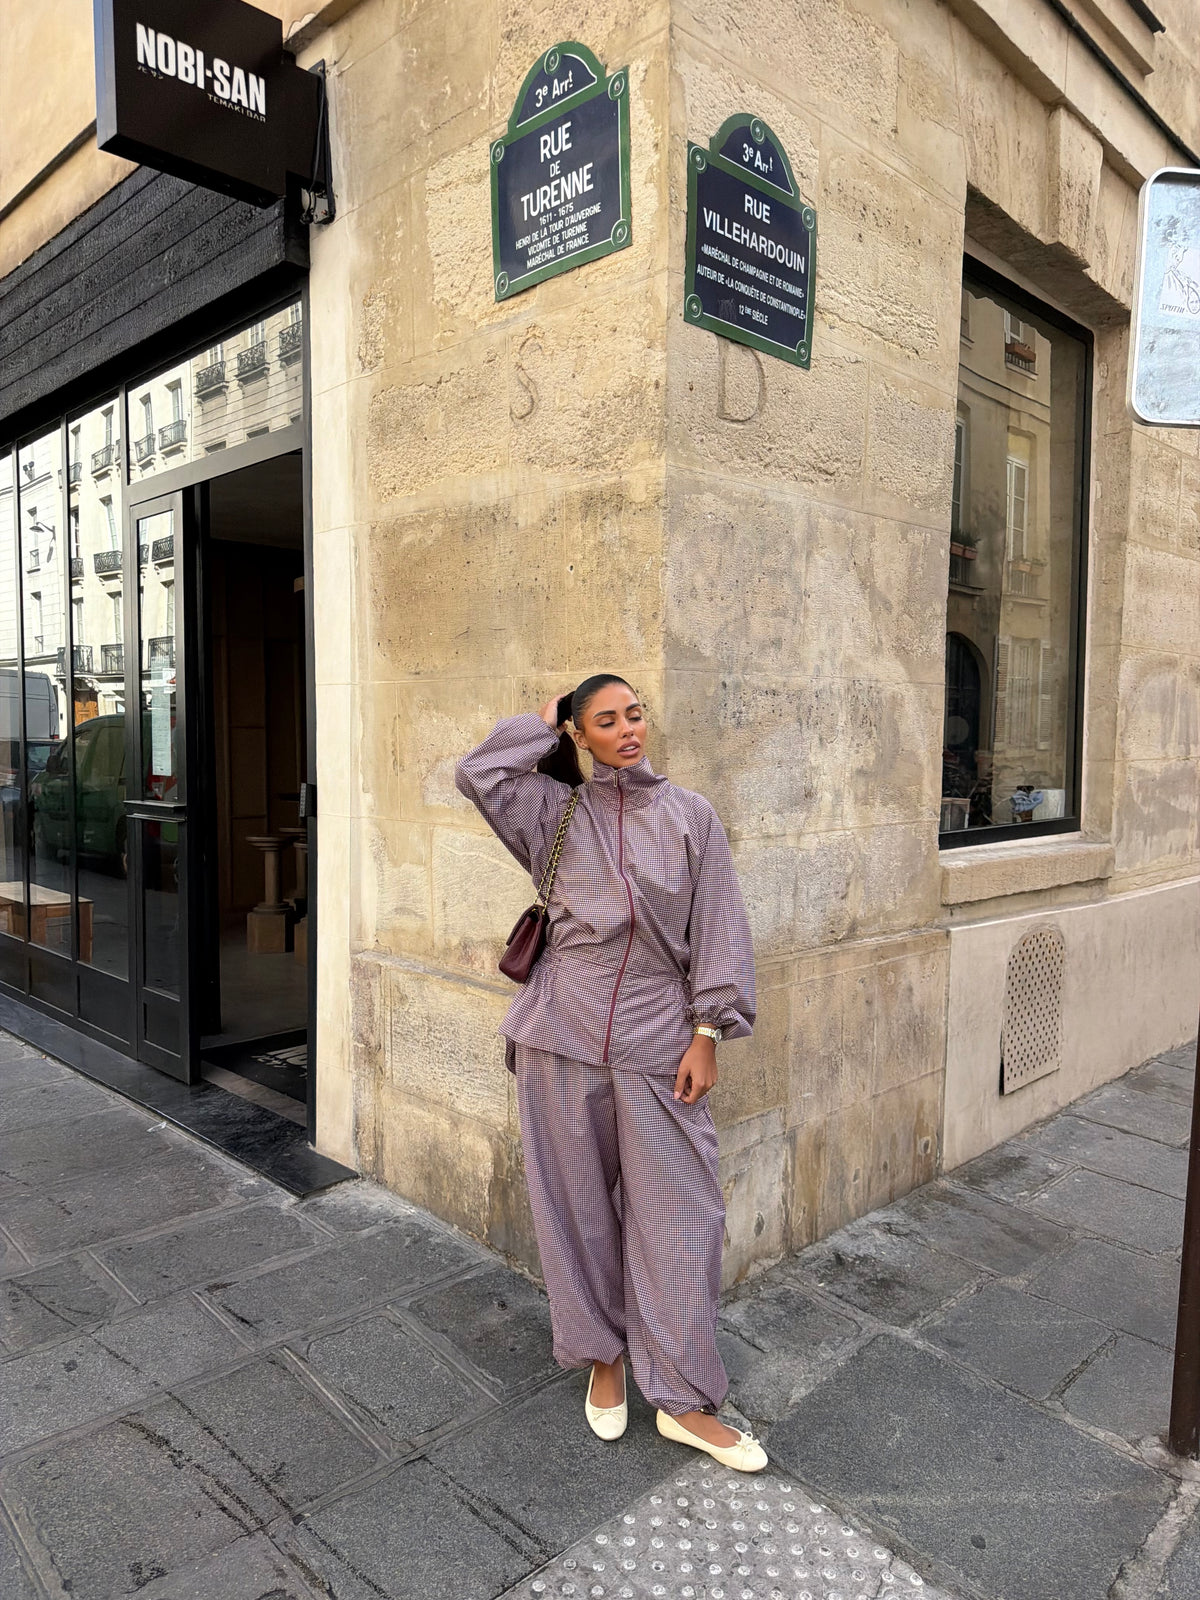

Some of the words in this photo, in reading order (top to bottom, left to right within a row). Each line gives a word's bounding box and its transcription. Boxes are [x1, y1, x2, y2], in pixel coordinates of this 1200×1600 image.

[136, 22, 266, 115] NOBI-SAN
[207, 93, 244, 114] TEMAKI
[246, 109, 266, 123] BAR
[540, 121, 572, 163] RUE
[549, 160, 561, 178] DE
[520, 162, 594, 221] TURENNE
[744, 193, 771, 225] RUE
[515, 234, 531, 250] HENRI
[532, 231, 540, 242] DE
[540, 227, 548, 238] LA
[549, 219, 564, 234] TOUR
[565, 202, 602, 227] D'AUVERGNE
[539, 212, 553, 226] 1611
[558, 202, 574, 217] 1675
[526, 249, 556, 269] MARÉCHAL
[556, 243, 565, 255] DE
[565, 233, 590, 251] FRANCE
[527, 237, 552, 256] VICOMTE
[552, 233, 560, 245] DE
[561, 221, 588, 241] TURENNE
[703, 206, 805, 274] VILLEHARDOUIN
[696, 263, 717, 282] AUTEUR
[717, 272, 725, 285] DE
[734, 280, 760, 300] CONQUÊTE
[759, 291, 766, 303] DE
[731, 256, 739, 269] DE
[739, 260, 769, 283] CHAMPAGNE
[769, 274, 776, 285] ET
[775, 277, 782, 289] DE
[751, 309, 769, 326] SIÈCLE
